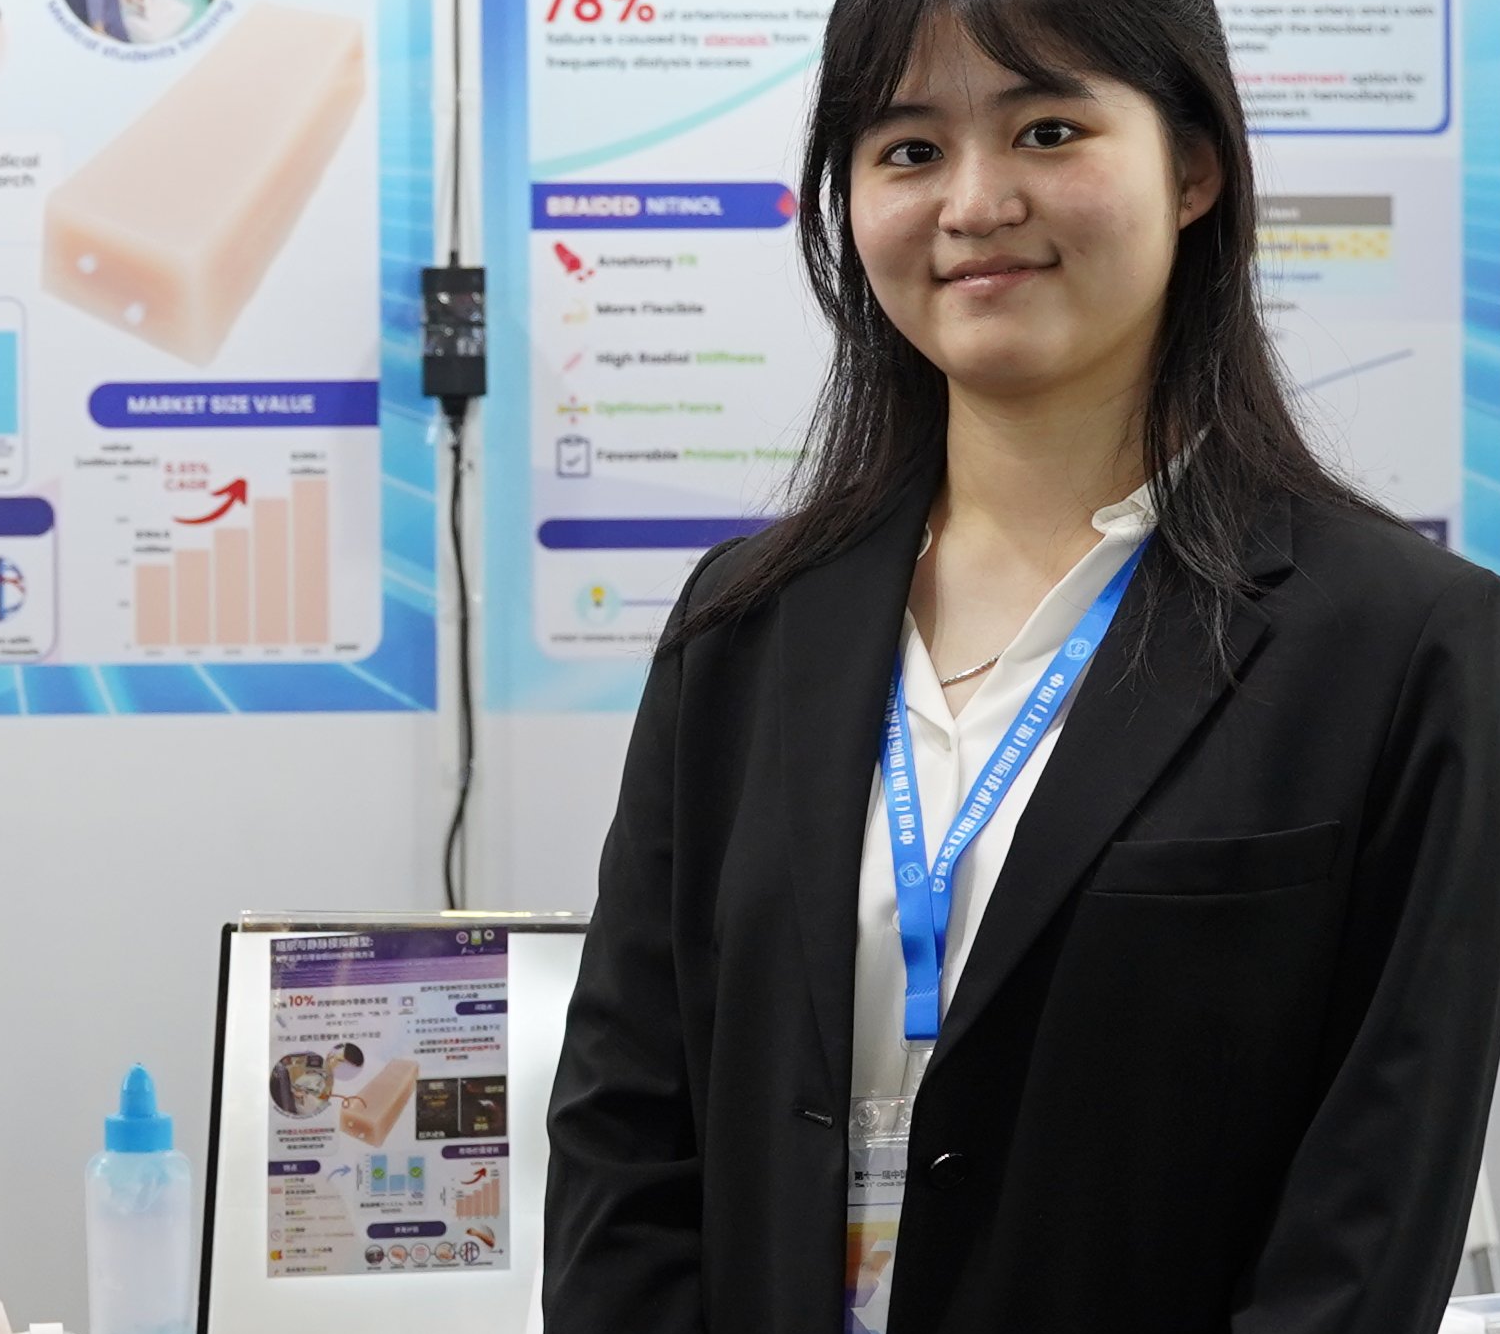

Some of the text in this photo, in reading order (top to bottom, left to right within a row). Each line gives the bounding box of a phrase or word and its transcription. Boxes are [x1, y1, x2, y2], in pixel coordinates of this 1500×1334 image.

[546, 196, 723, 217] BRAIDED NITINOL
[127, 396, 209, 415] MARKET
[252, 394, 316, 414] VALUE
[288, 995, 316, 1008] 10%
